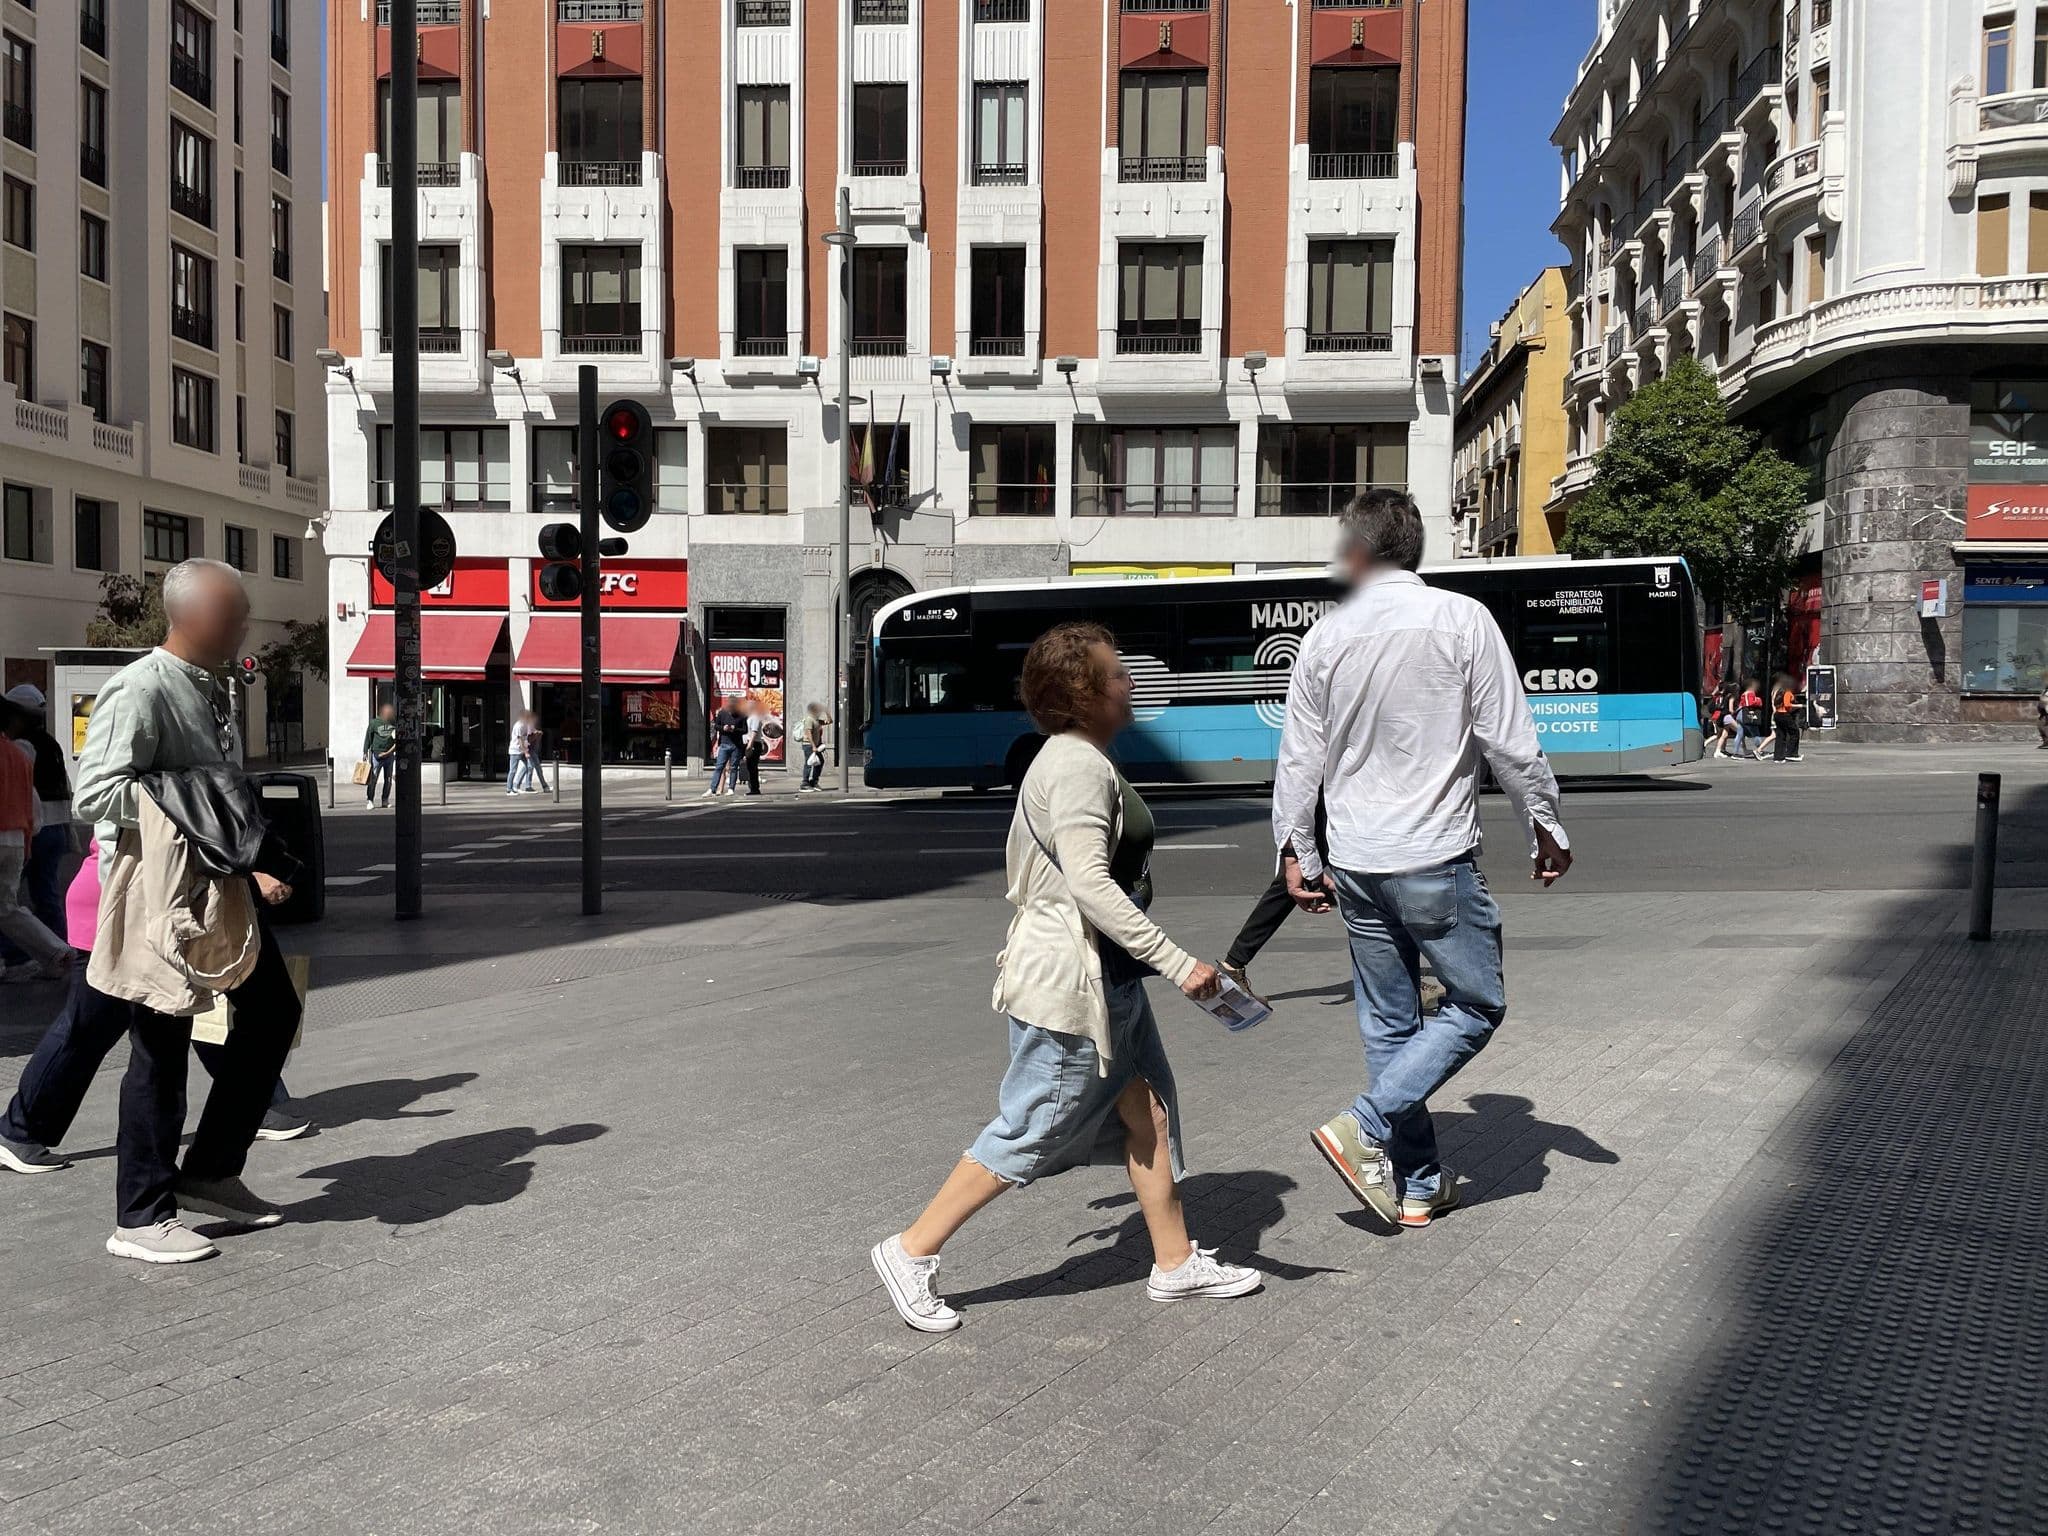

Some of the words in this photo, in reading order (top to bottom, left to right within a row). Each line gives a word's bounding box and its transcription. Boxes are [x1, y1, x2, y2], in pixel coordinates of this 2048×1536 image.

[600, 573, 637, 592] FC
[1555, 590, 1603, 599] ESTRATEGIA
[1648, 590, 1677, 599] MADRID
[1526, 599, 1538, 608] DE
[1539, 597, 1604, 608] SOSTENIBILIDAD
[1558, 606, 1604, 615] AMBIENTAL
[713, 655, 747, 673] CUBOS
[714, 672, 739, 689] PARA
[740, 672, 748, 689] 2
[1523, 667, 1599, 691] CERO
[1528, 702, 1599, 715] MISIONES
[1550, 720, 1599, 733] COSTE
[1361, 1162, 1383, 1185] N
